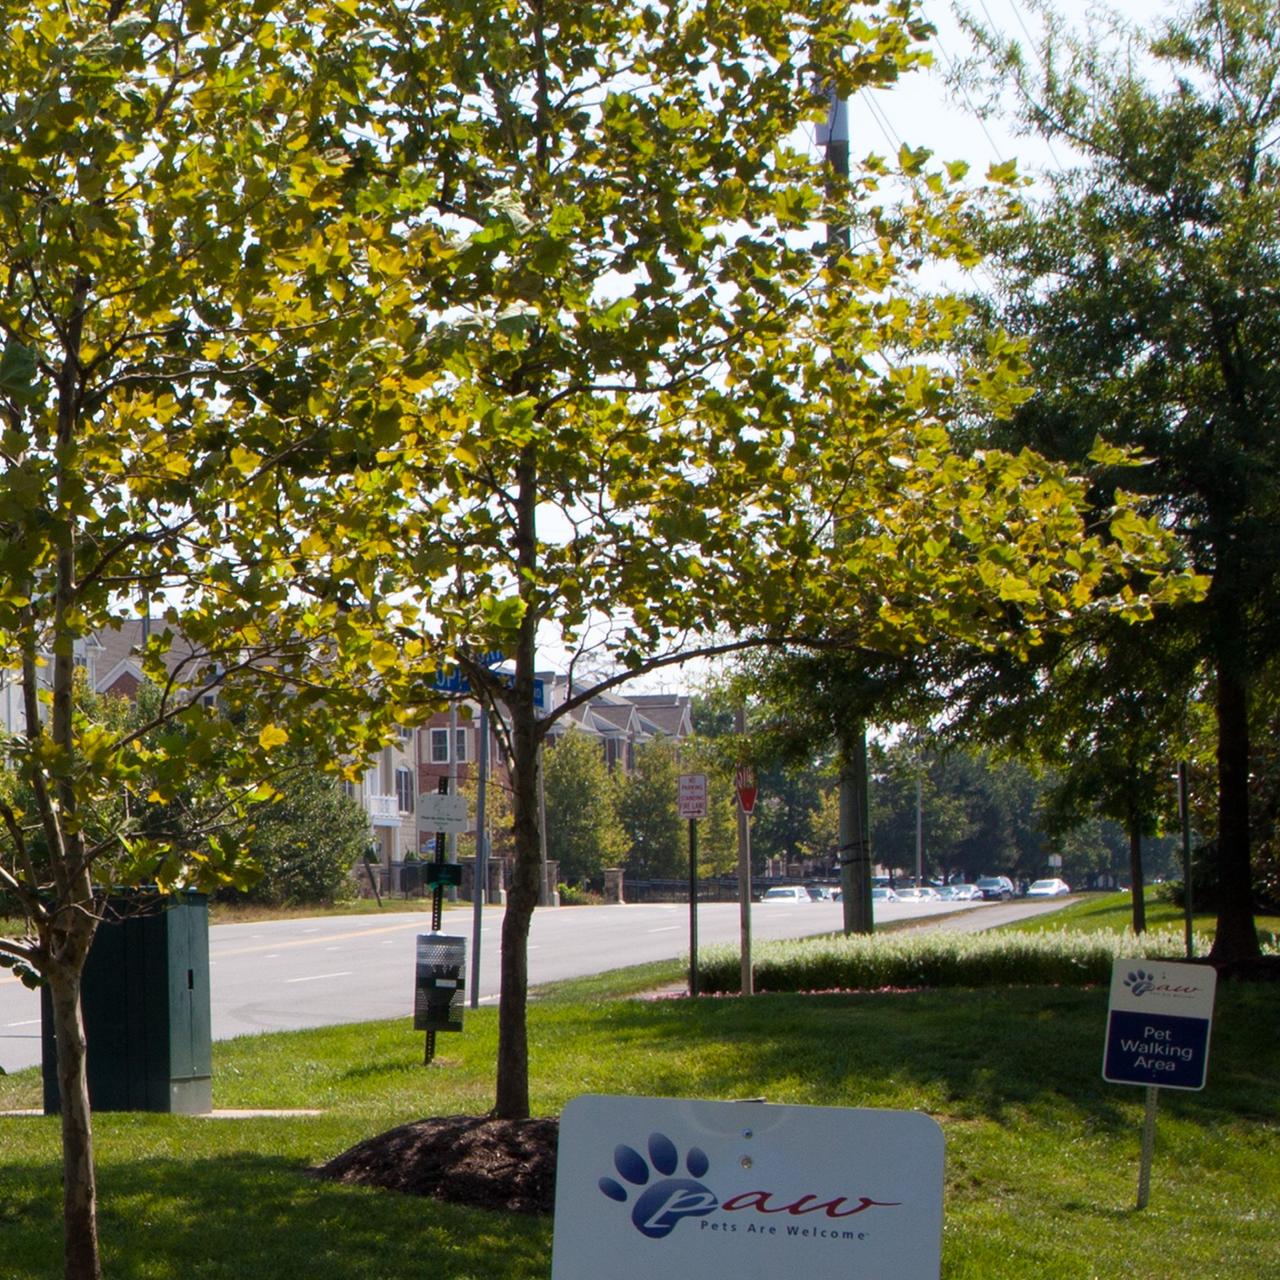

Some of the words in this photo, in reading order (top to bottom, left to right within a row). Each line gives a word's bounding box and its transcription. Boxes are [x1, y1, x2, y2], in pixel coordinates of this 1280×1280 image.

[1144, 1026, 1172, 1041] Pet
[1120, 1039, 1193, 1061] Walking
[1134, 1056, 1176, 1071] Area
[700, 1220, 737, 1232] Pets
[747, 1223, 776, 1235] Are
[787, 1224, 867, 1241] Welcome
